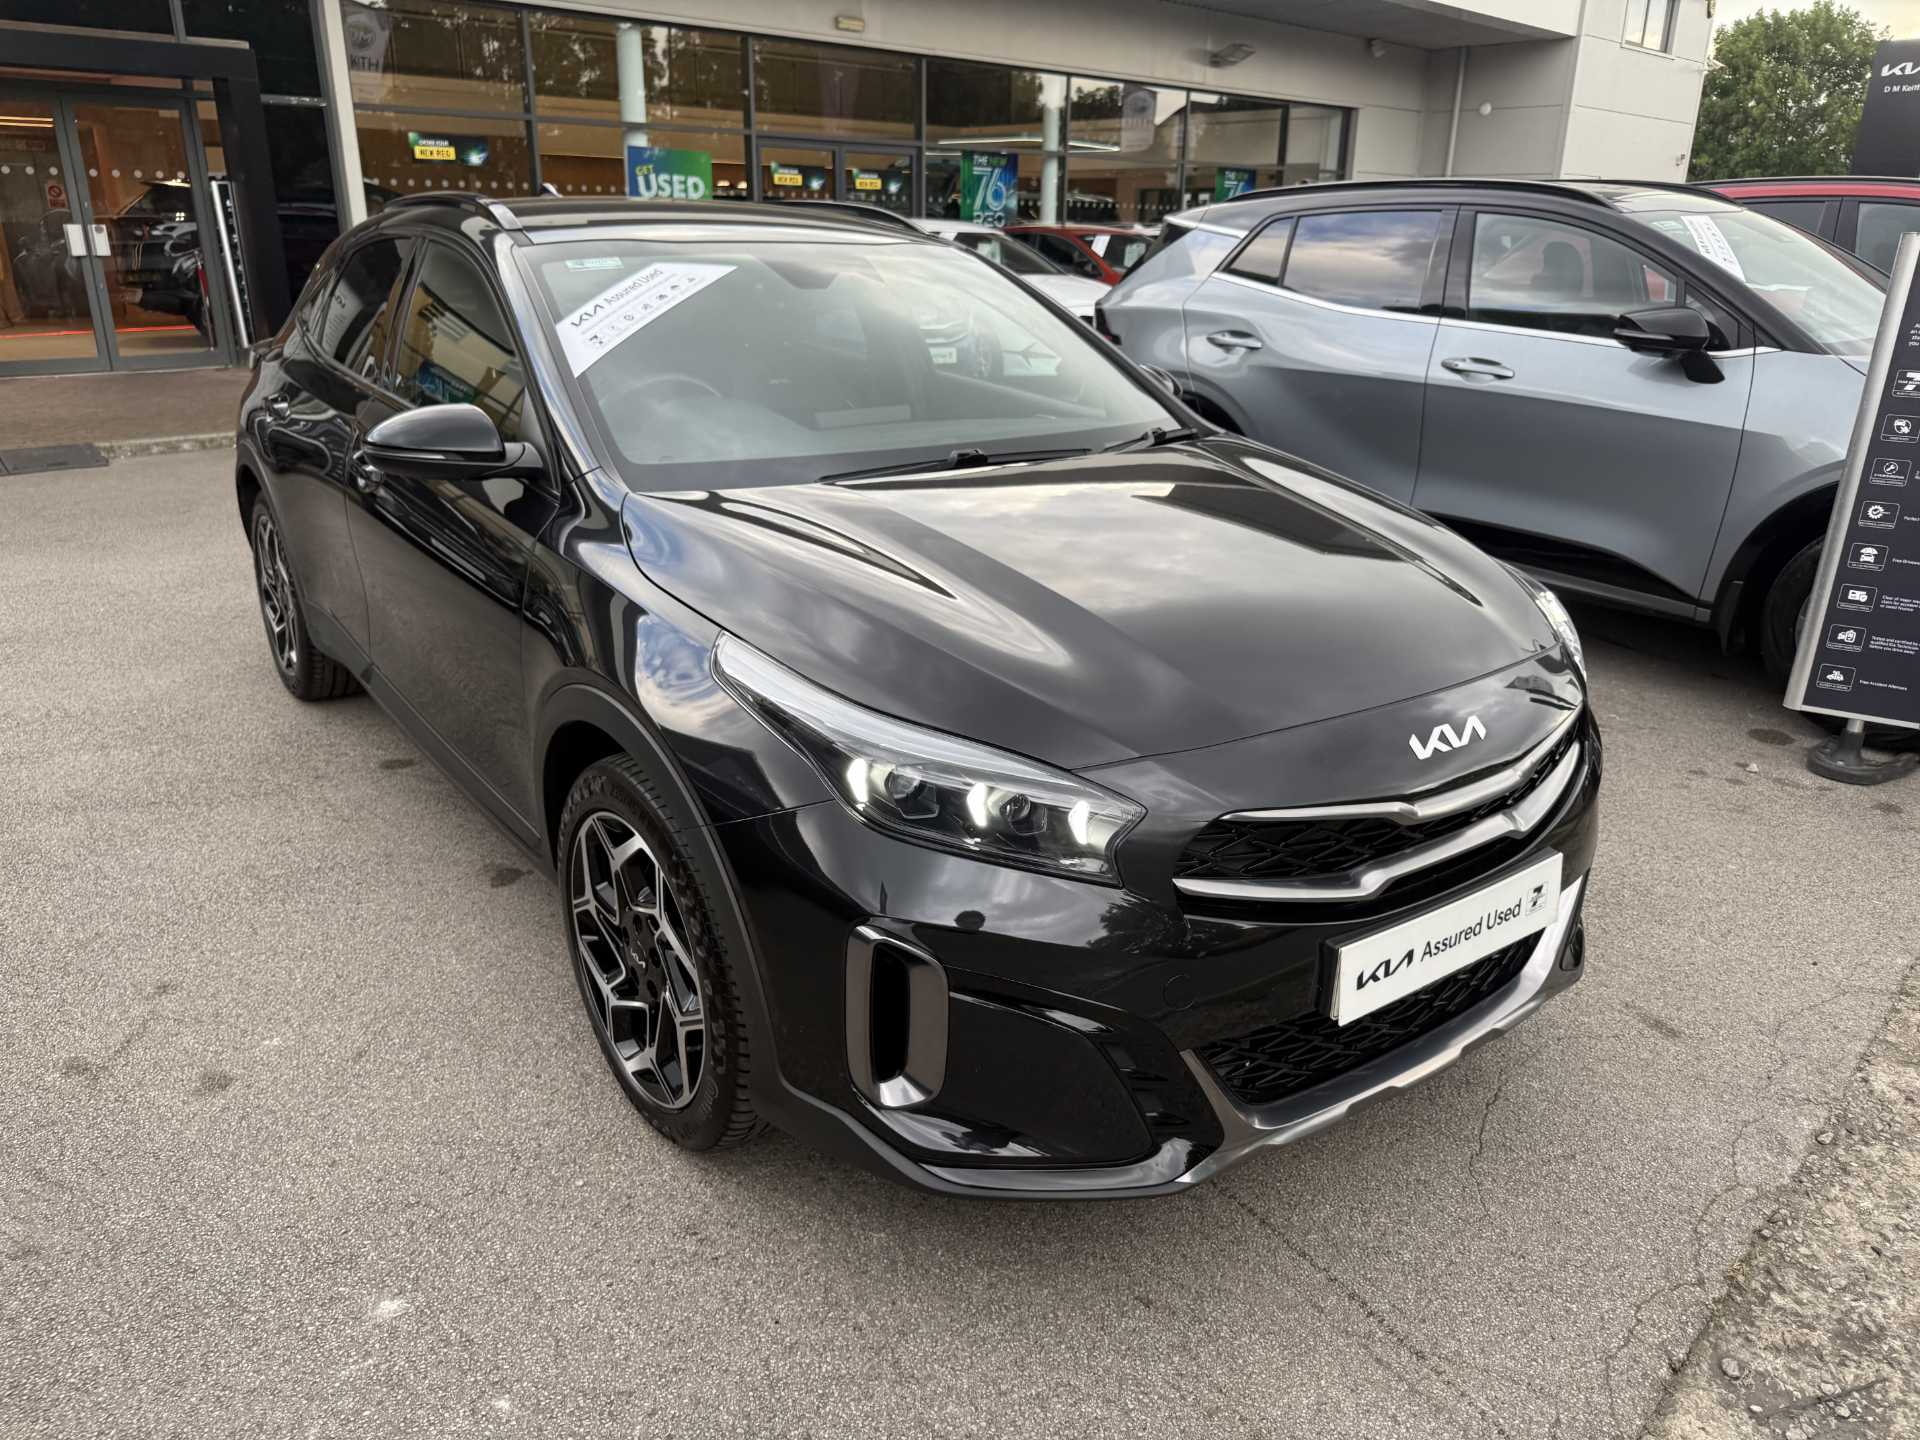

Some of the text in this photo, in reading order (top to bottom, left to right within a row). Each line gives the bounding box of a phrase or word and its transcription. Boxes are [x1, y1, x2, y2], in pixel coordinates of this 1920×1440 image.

[637, 172, 705, 200] USED
[571, 304, 604, 327] KIA
[1408, 715, 1487, 760] KIA
[1356, 898, 1522, 991] KIA Assured Used
